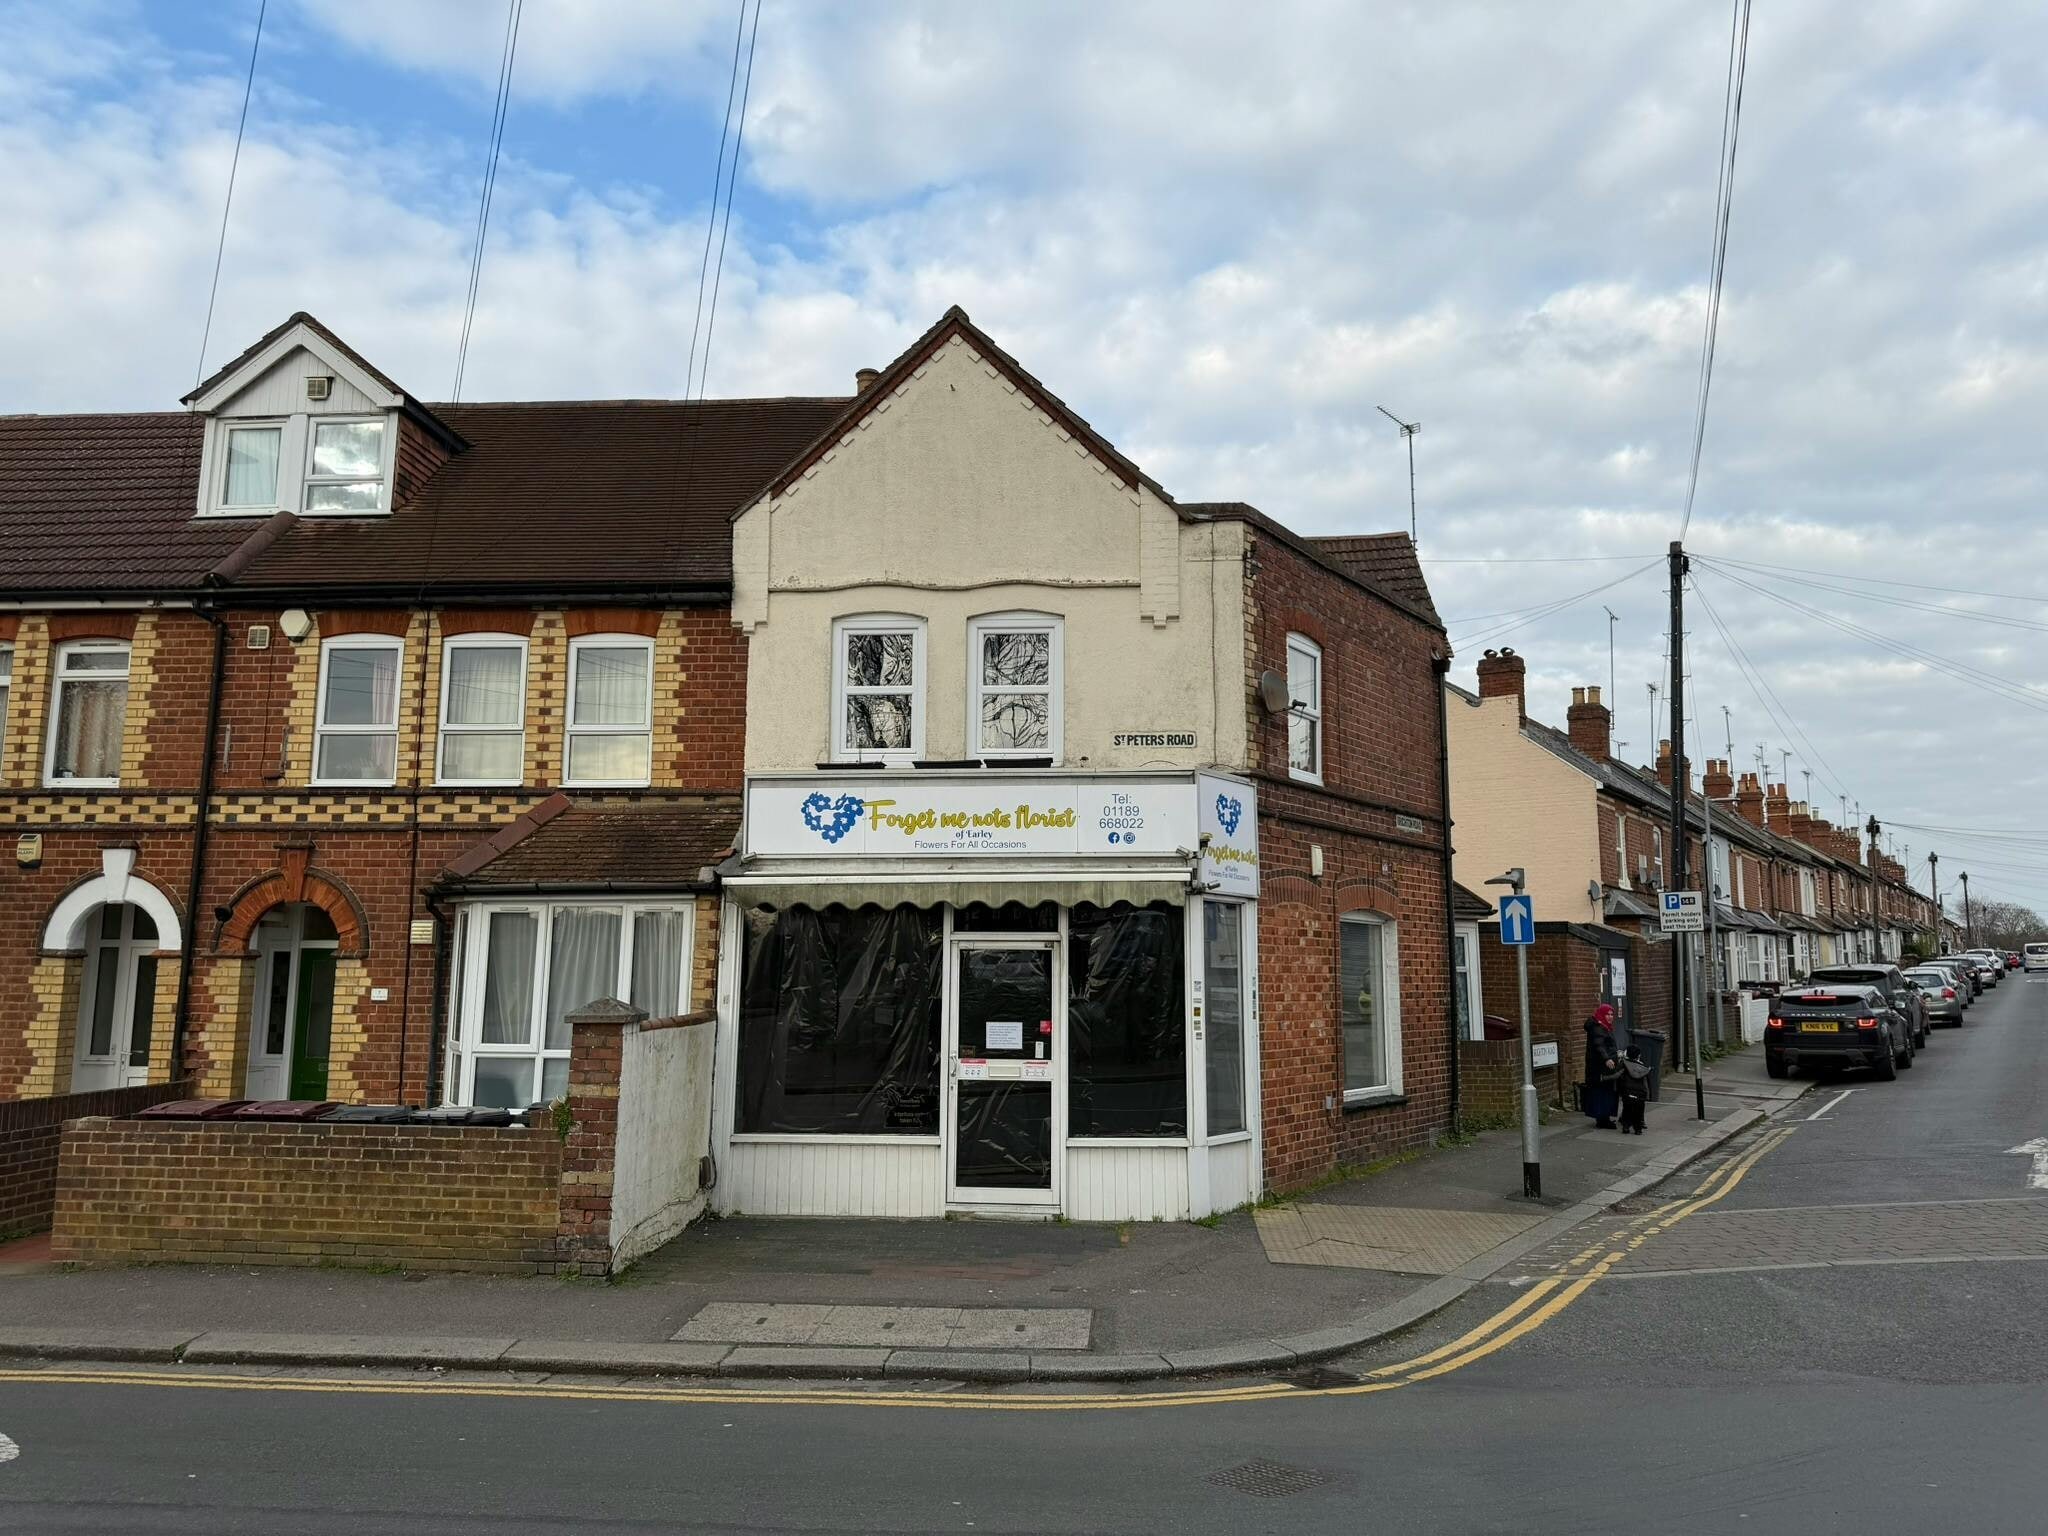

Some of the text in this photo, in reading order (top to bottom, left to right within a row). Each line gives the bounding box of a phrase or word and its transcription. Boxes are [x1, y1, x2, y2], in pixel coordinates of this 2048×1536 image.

[1127, 734, 1165, 746] PETERS
[1167, 734, 1194, 746] ROAD
[1111, 793, 1132, 804] Tel:
[1103, 806, 1140, 817] 01189
[861, 799, 1076, 836] Forget me nots florist
[1099, 818, 1144, 829] 668022
[955, 829, 993, 840] of Earley
[914, 840, 1027, 849] Flowers For All Occasions
[1668, 895, 1678, 908] P
